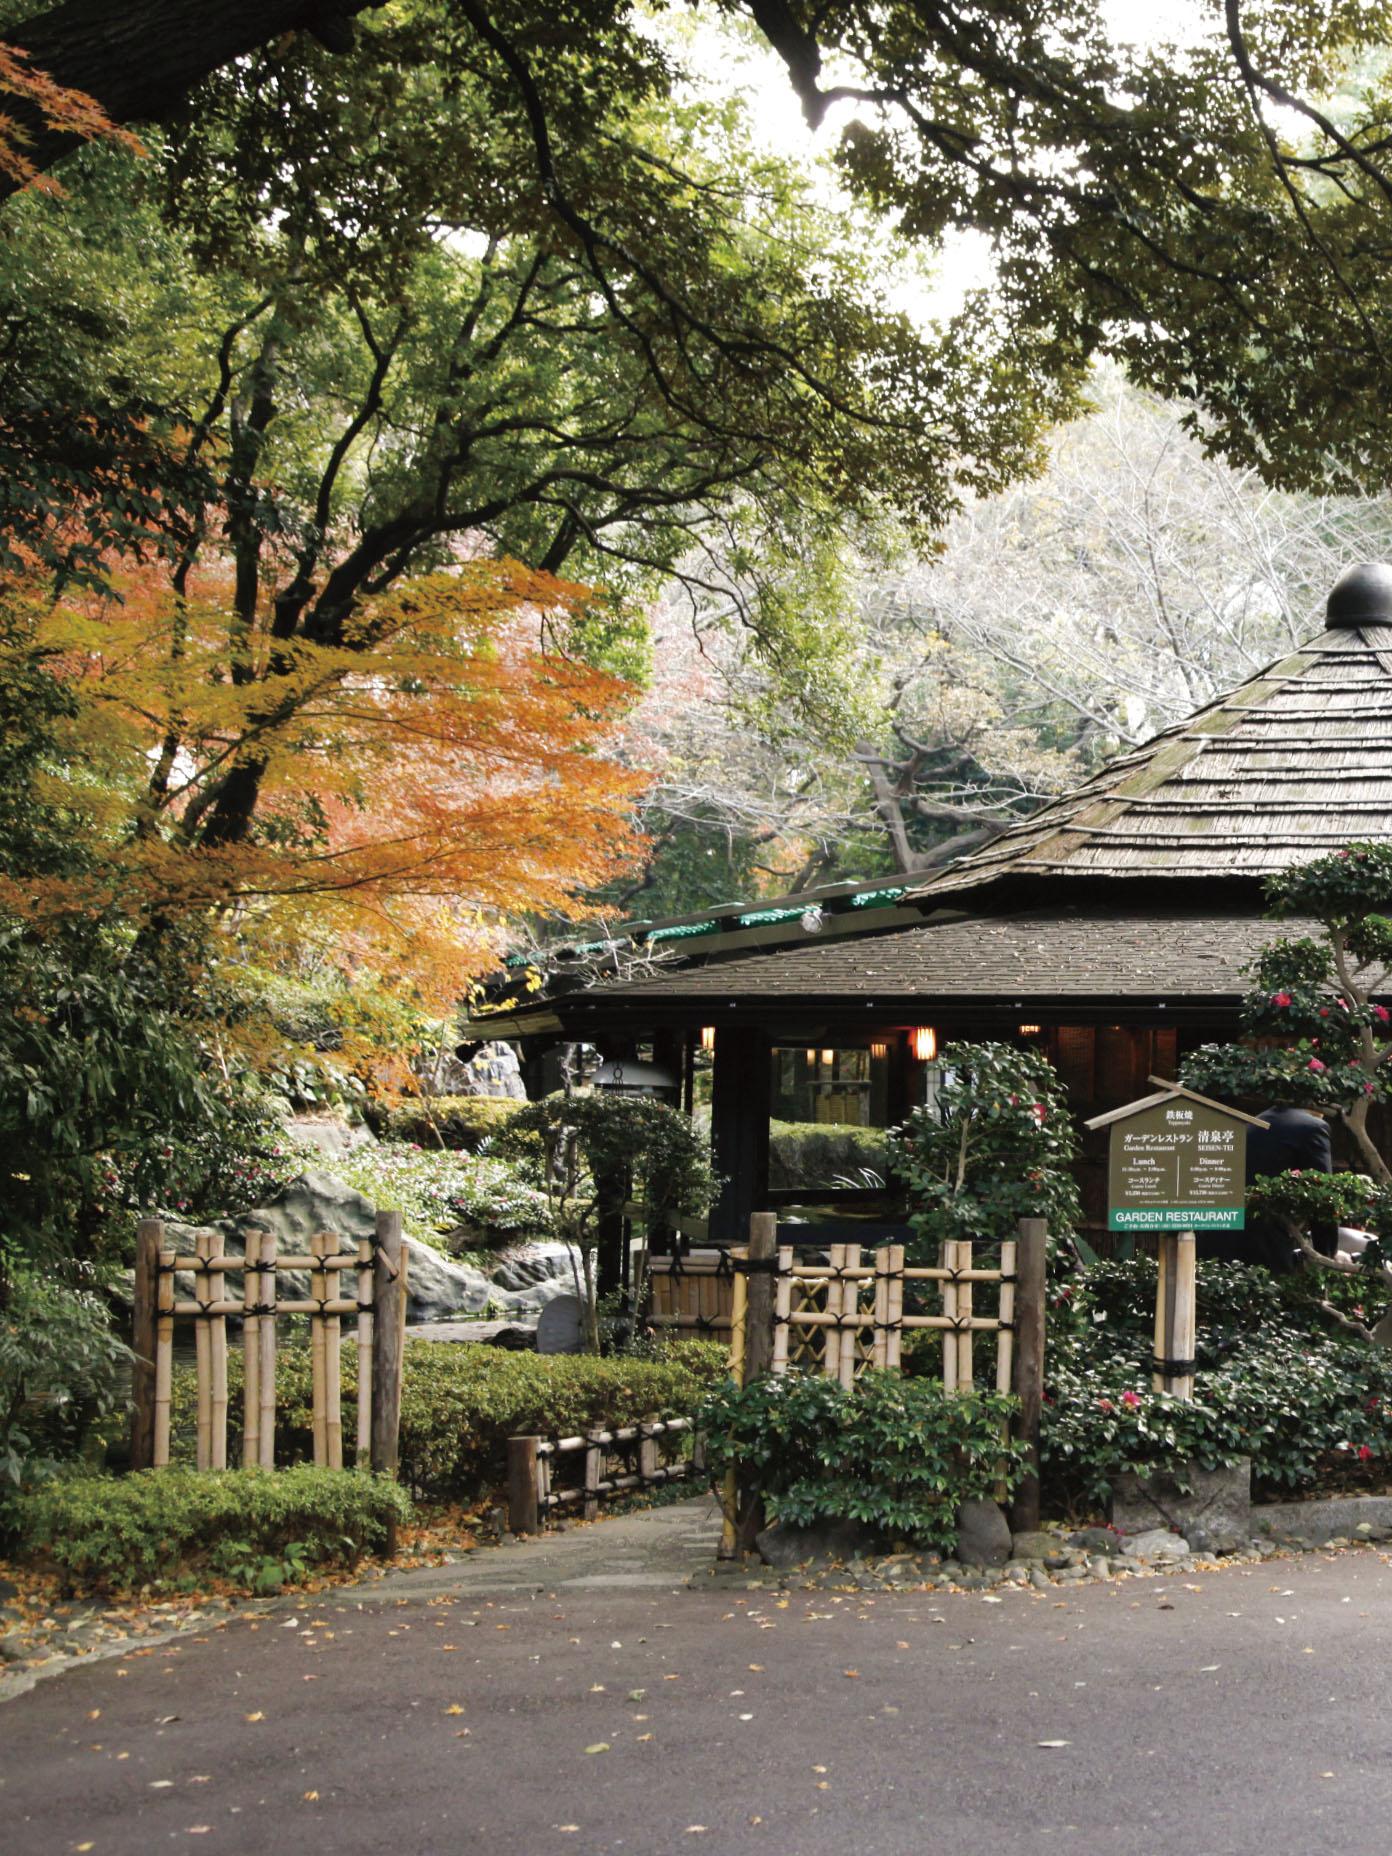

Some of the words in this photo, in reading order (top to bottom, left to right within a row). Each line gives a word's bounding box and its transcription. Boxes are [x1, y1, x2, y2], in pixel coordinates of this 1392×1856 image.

[1166, 1110, 1193, 1120] 鉄板焼
[1124, 1133, 1194, 1143] ガーデンレストラン
[1197, 1130, 1234, 1143] 清泉亭
[1133, 1157, 1156, 1166] Lunch
[1199, 1157, 1225, 1166] Dinner
[1115, 1212, 1163, 1222] GARDEN
[1165, 1211, 1239, 1222] RESTAURANT
